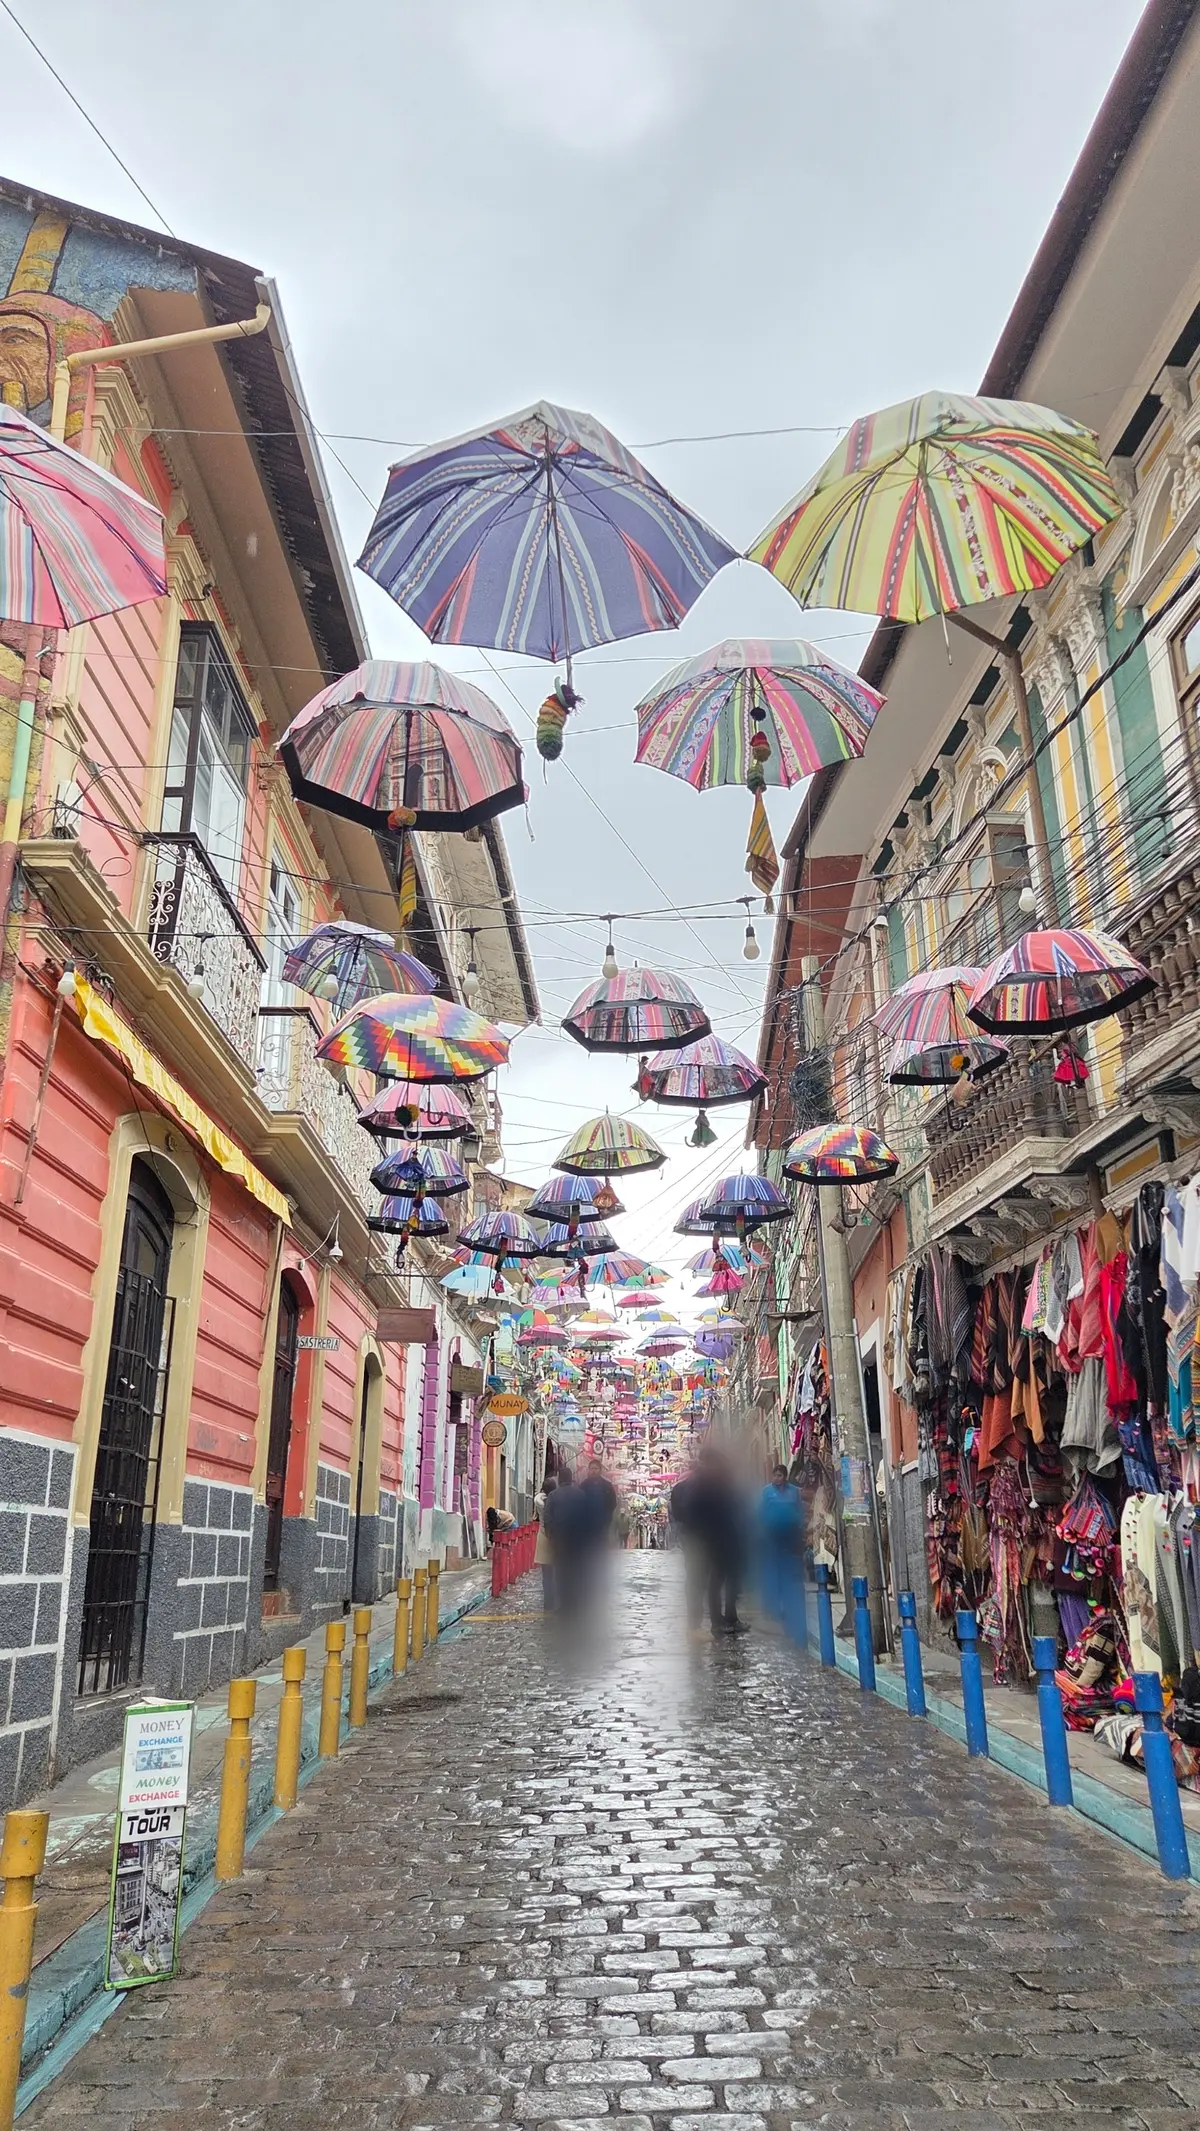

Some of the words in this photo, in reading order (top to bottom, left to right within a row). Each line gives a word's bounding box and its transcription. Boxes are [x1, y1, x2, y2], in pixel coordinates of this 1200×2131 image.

[300, 1337, 338, 1349] SASTRERIA
[490, 1400, 524, 1410] MUNAY
[140, 1718, 184, 1733] MONEY
[139, 1736, 183, 1747] EXCHANGE
[129, 1791, 180, 1803] EXCHANGE
[127, 1815, 171, 1835] TOUR
